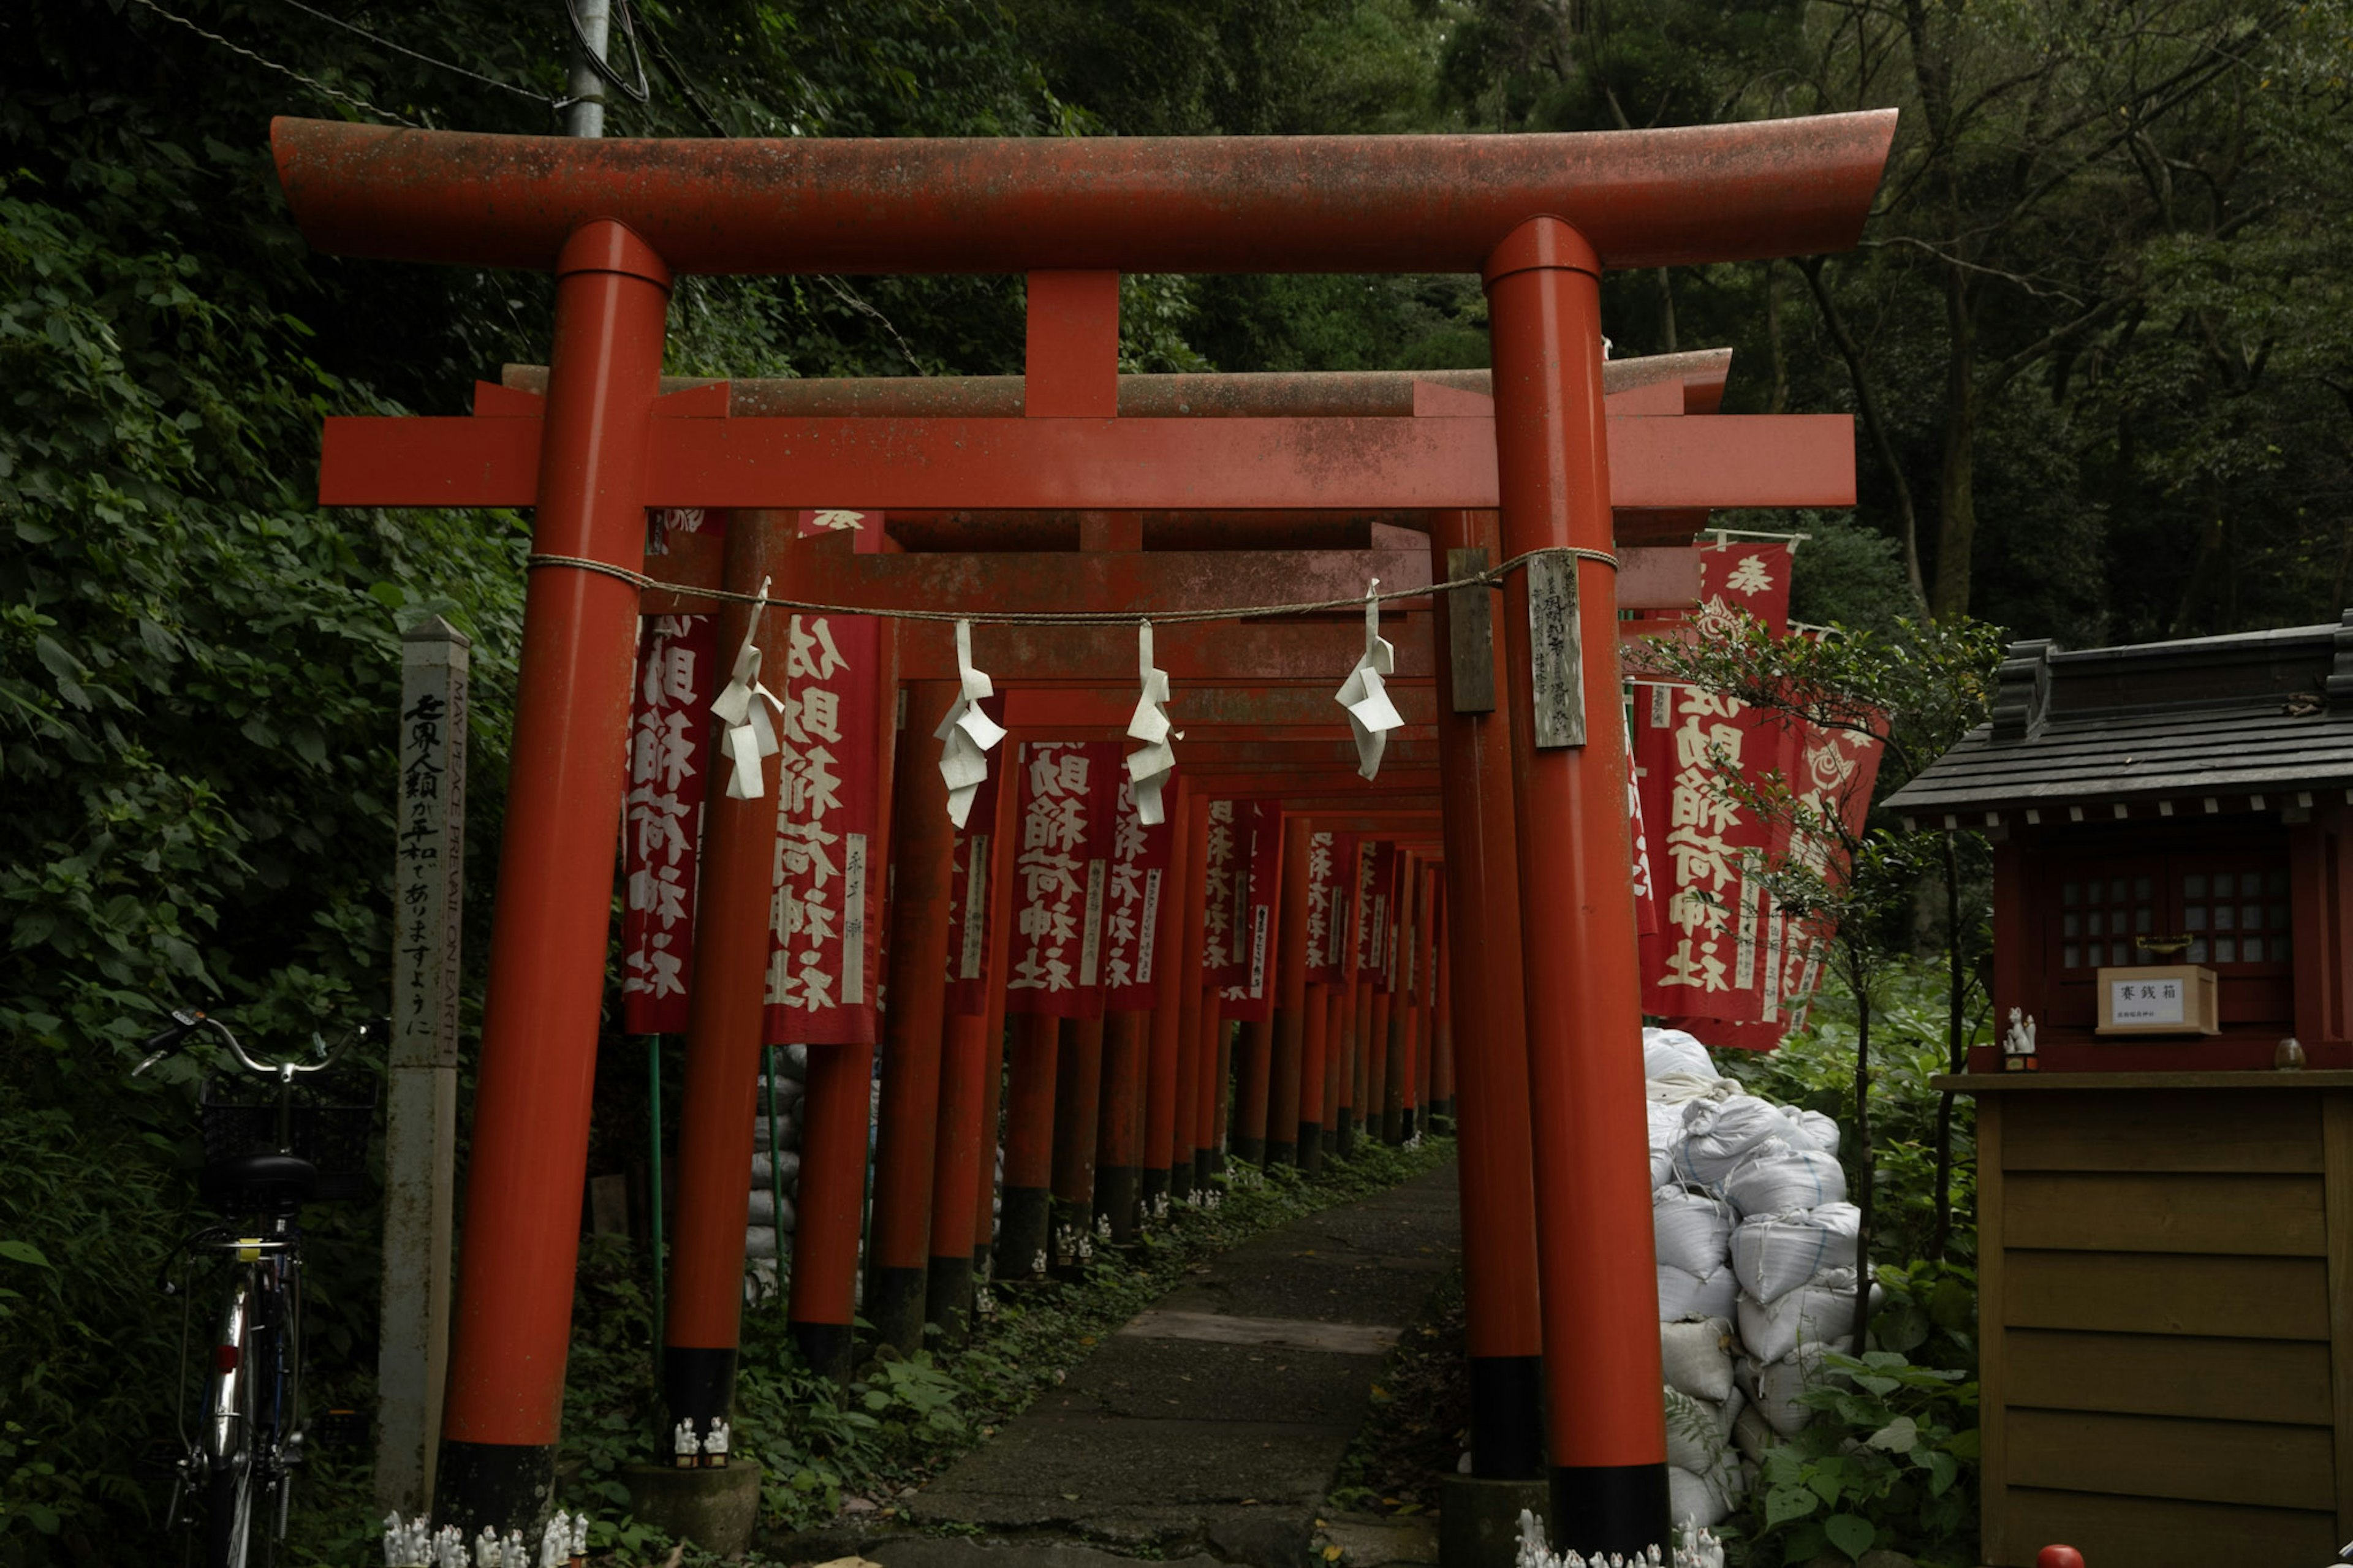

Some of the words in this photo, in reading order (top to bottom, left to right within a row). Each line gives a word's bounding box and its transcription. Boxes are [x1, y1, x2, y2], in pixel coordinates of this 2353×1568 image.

[453, 681, 463, 734] MAY
[450, 741, 463, 816] PEACE
[399, 694, 445, 1035] 世界人類が平和でありますように
[448, 825, 461, 917] PREVAIL
[447, 925, 457, 961] ON
[444, 969, 457, 1055] EARTH
